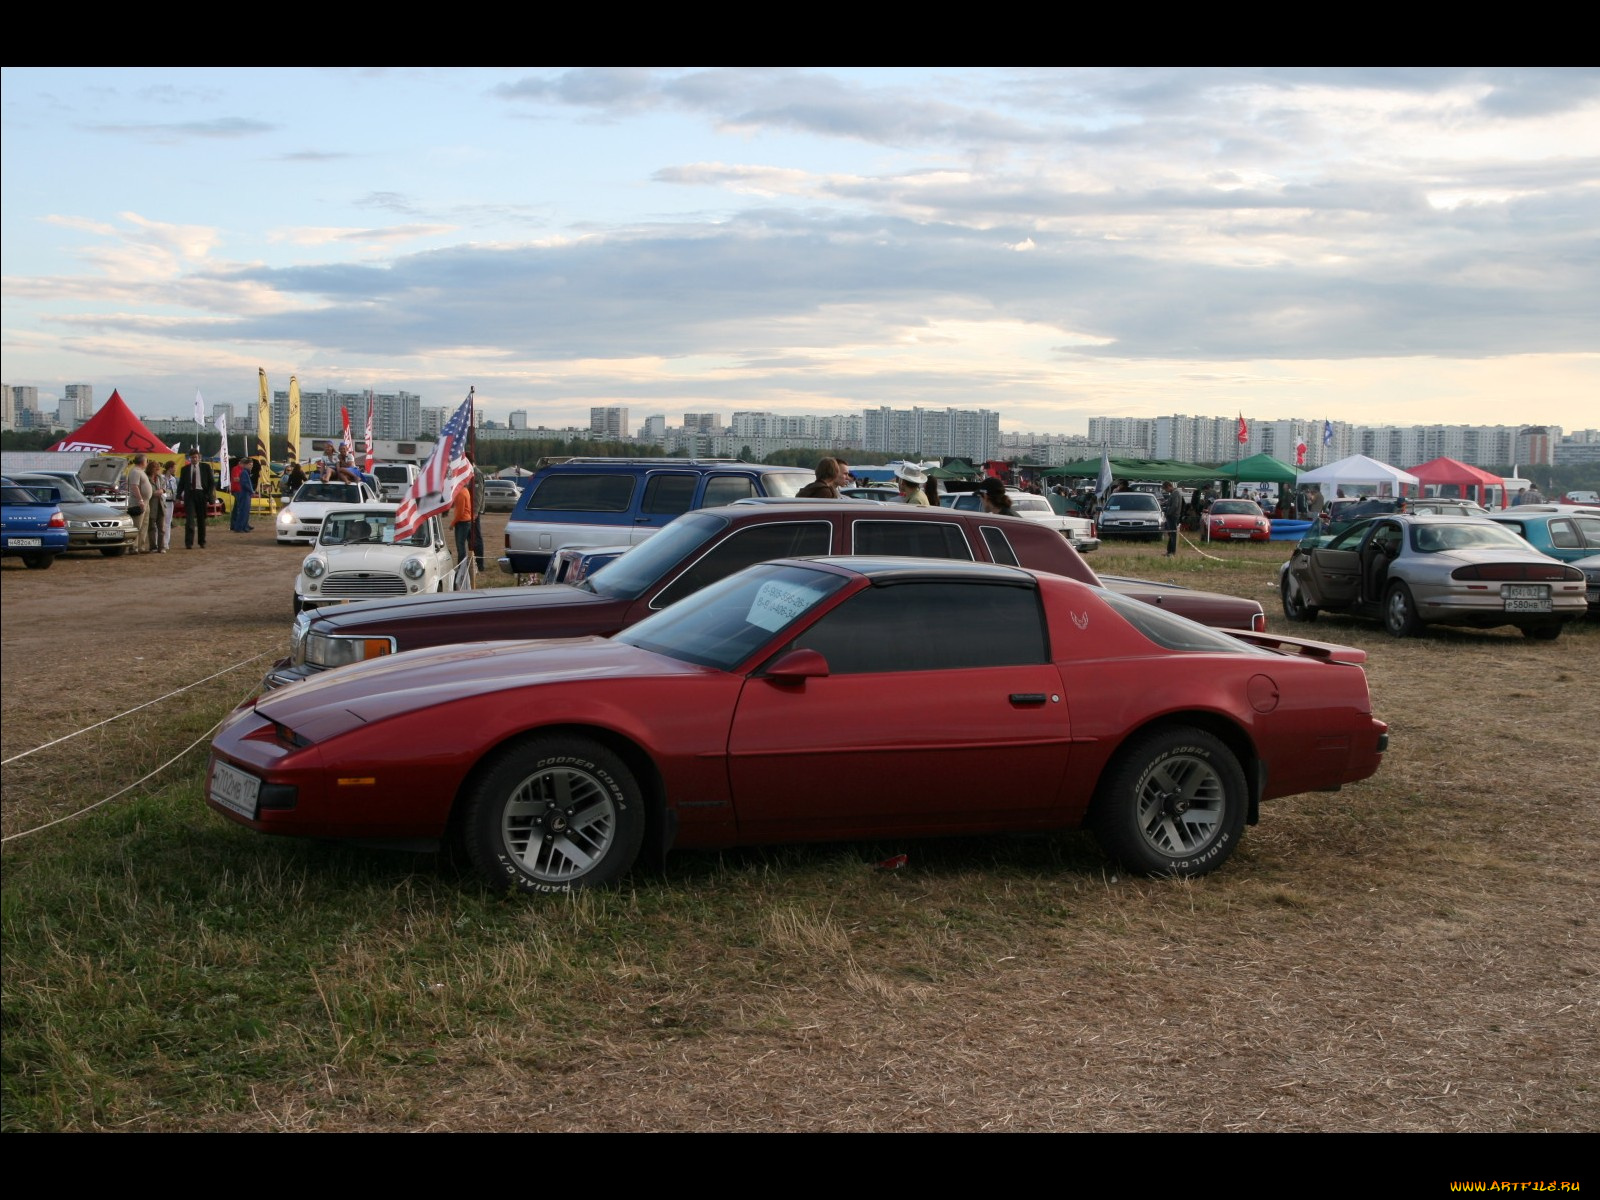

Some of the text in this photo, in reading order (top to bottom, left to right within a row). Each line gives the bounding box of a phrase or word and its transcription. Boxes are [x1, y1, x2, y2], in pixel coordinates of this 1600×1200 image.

[1172, 746, 1211, 758] COBRA
[536, 756, 627, 811] COOPER COBRA
[1192, 832, 1229, 865] RADIAL
[519, 875, 571, 893] RADIAL
